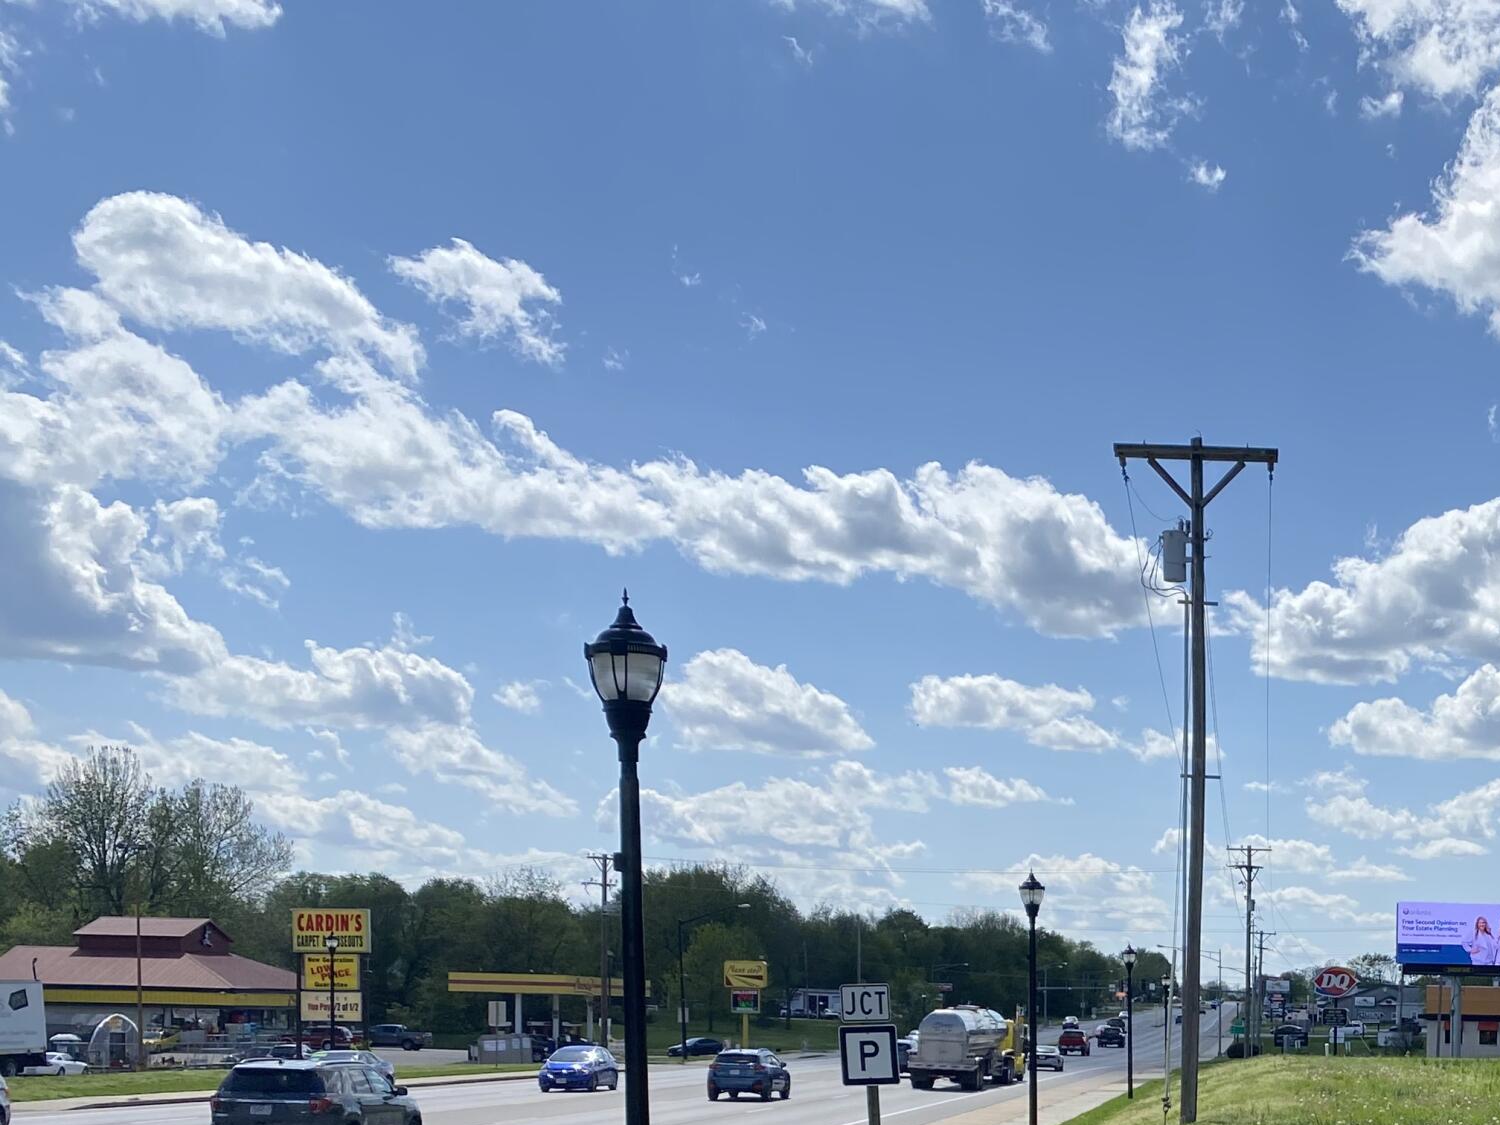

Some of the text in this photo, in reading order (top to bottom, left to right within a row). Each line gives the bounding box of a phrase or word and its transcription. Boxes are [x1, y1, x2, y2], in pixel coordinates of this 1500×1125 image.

[297, 913, 362, 931] CARDIN'S
[297, 935, 319, 947] CARPET
[1321, 973, 1350, 990] DQ
[845, 991, 886, 1015] JCT
[859, 1040, 879, 1072] P
